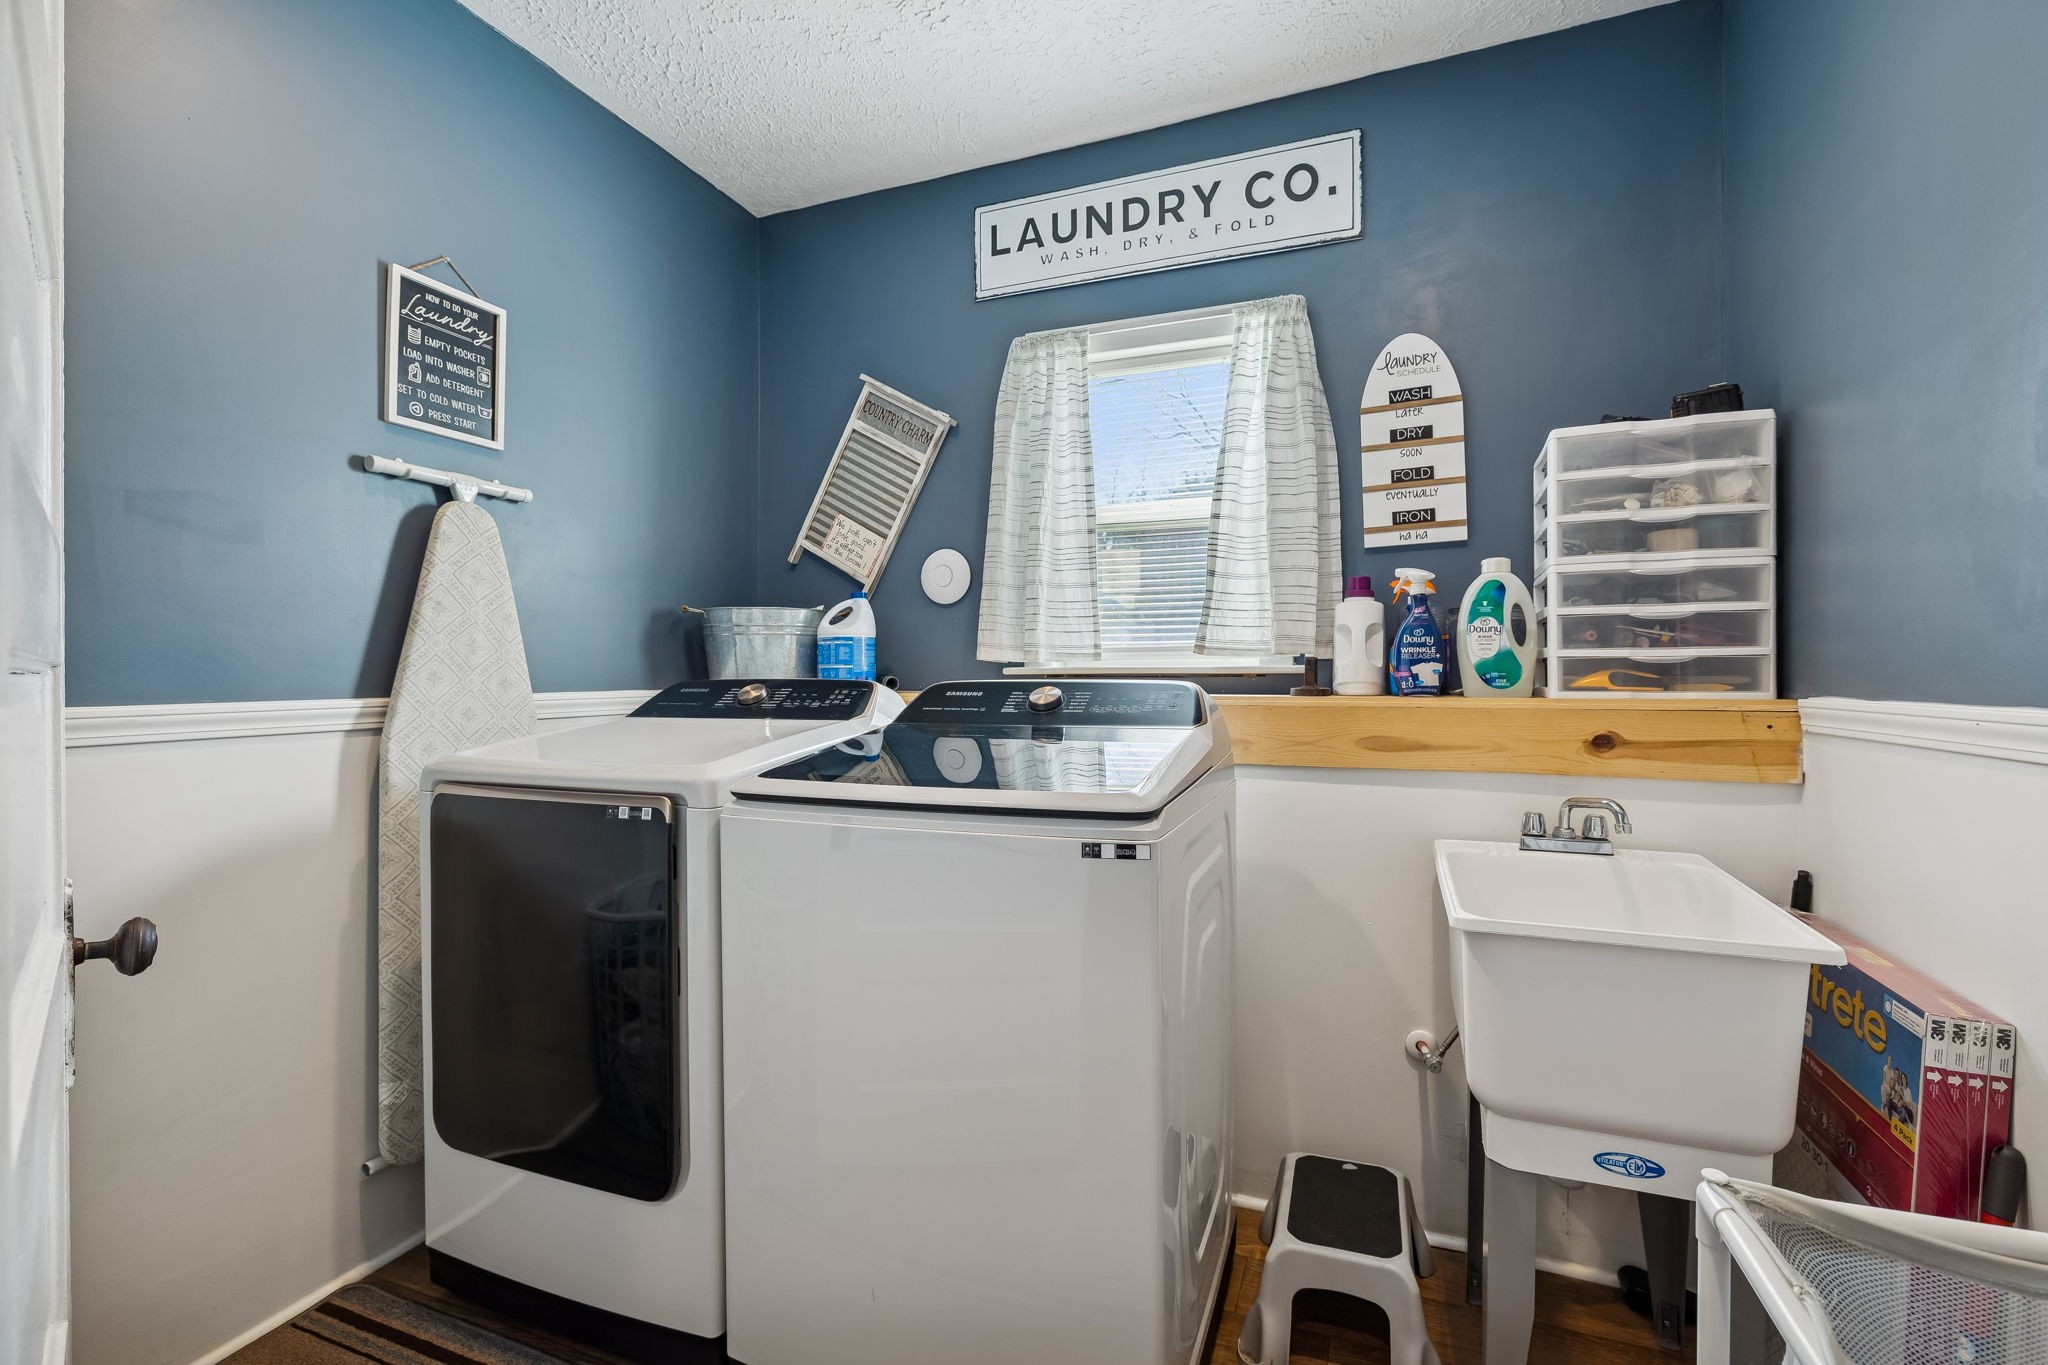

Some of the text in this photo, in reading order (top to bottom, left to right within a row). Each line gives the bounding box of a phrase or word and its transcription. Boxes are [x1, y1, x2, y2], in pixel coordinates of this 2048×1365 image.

[990, 162, 1337, 257] LAUNDRY CO.
[1040, 214, 1276, 265] WASH, DRY, & FOLD
[425, 293, 479, 320] HOW TO DO YOUR
[401, 294, 494, 346] Laundry
[424, 336, 486, 365] EMPTY POCKETS
[403, 346, 475, 379] LOAD INTO WASHER
[1396, 364, 1442, 377] SCHEDULE
[426, 372, 485, 398] ADD DETERGENT
[1390, 386, 1432, 402] WASH
[397, 383, 476, 415] SET TO COLD WATER
[428, 409, 477, 430] PRESS START
[863, 400, 934, 446] COUNTRY CHARM
[1396, 427, 1425, 440] DRY
[1393, 467, 1431, 481] FOLD
[1396, 509, 1431, 523] IRON
[1399, 529, 1428, 541] ha ha
[1403, 634, 1434, 646] Downy
[1469, 624, 1502, 636] Downy
[1931, 1020, 1946, 1041] 3M
[1952, 1023, 1966, 1045] 3M
[1996, 1028, 2012, 1050] 3M
[1893, 1123, 1913, 1144] 4 Pack
